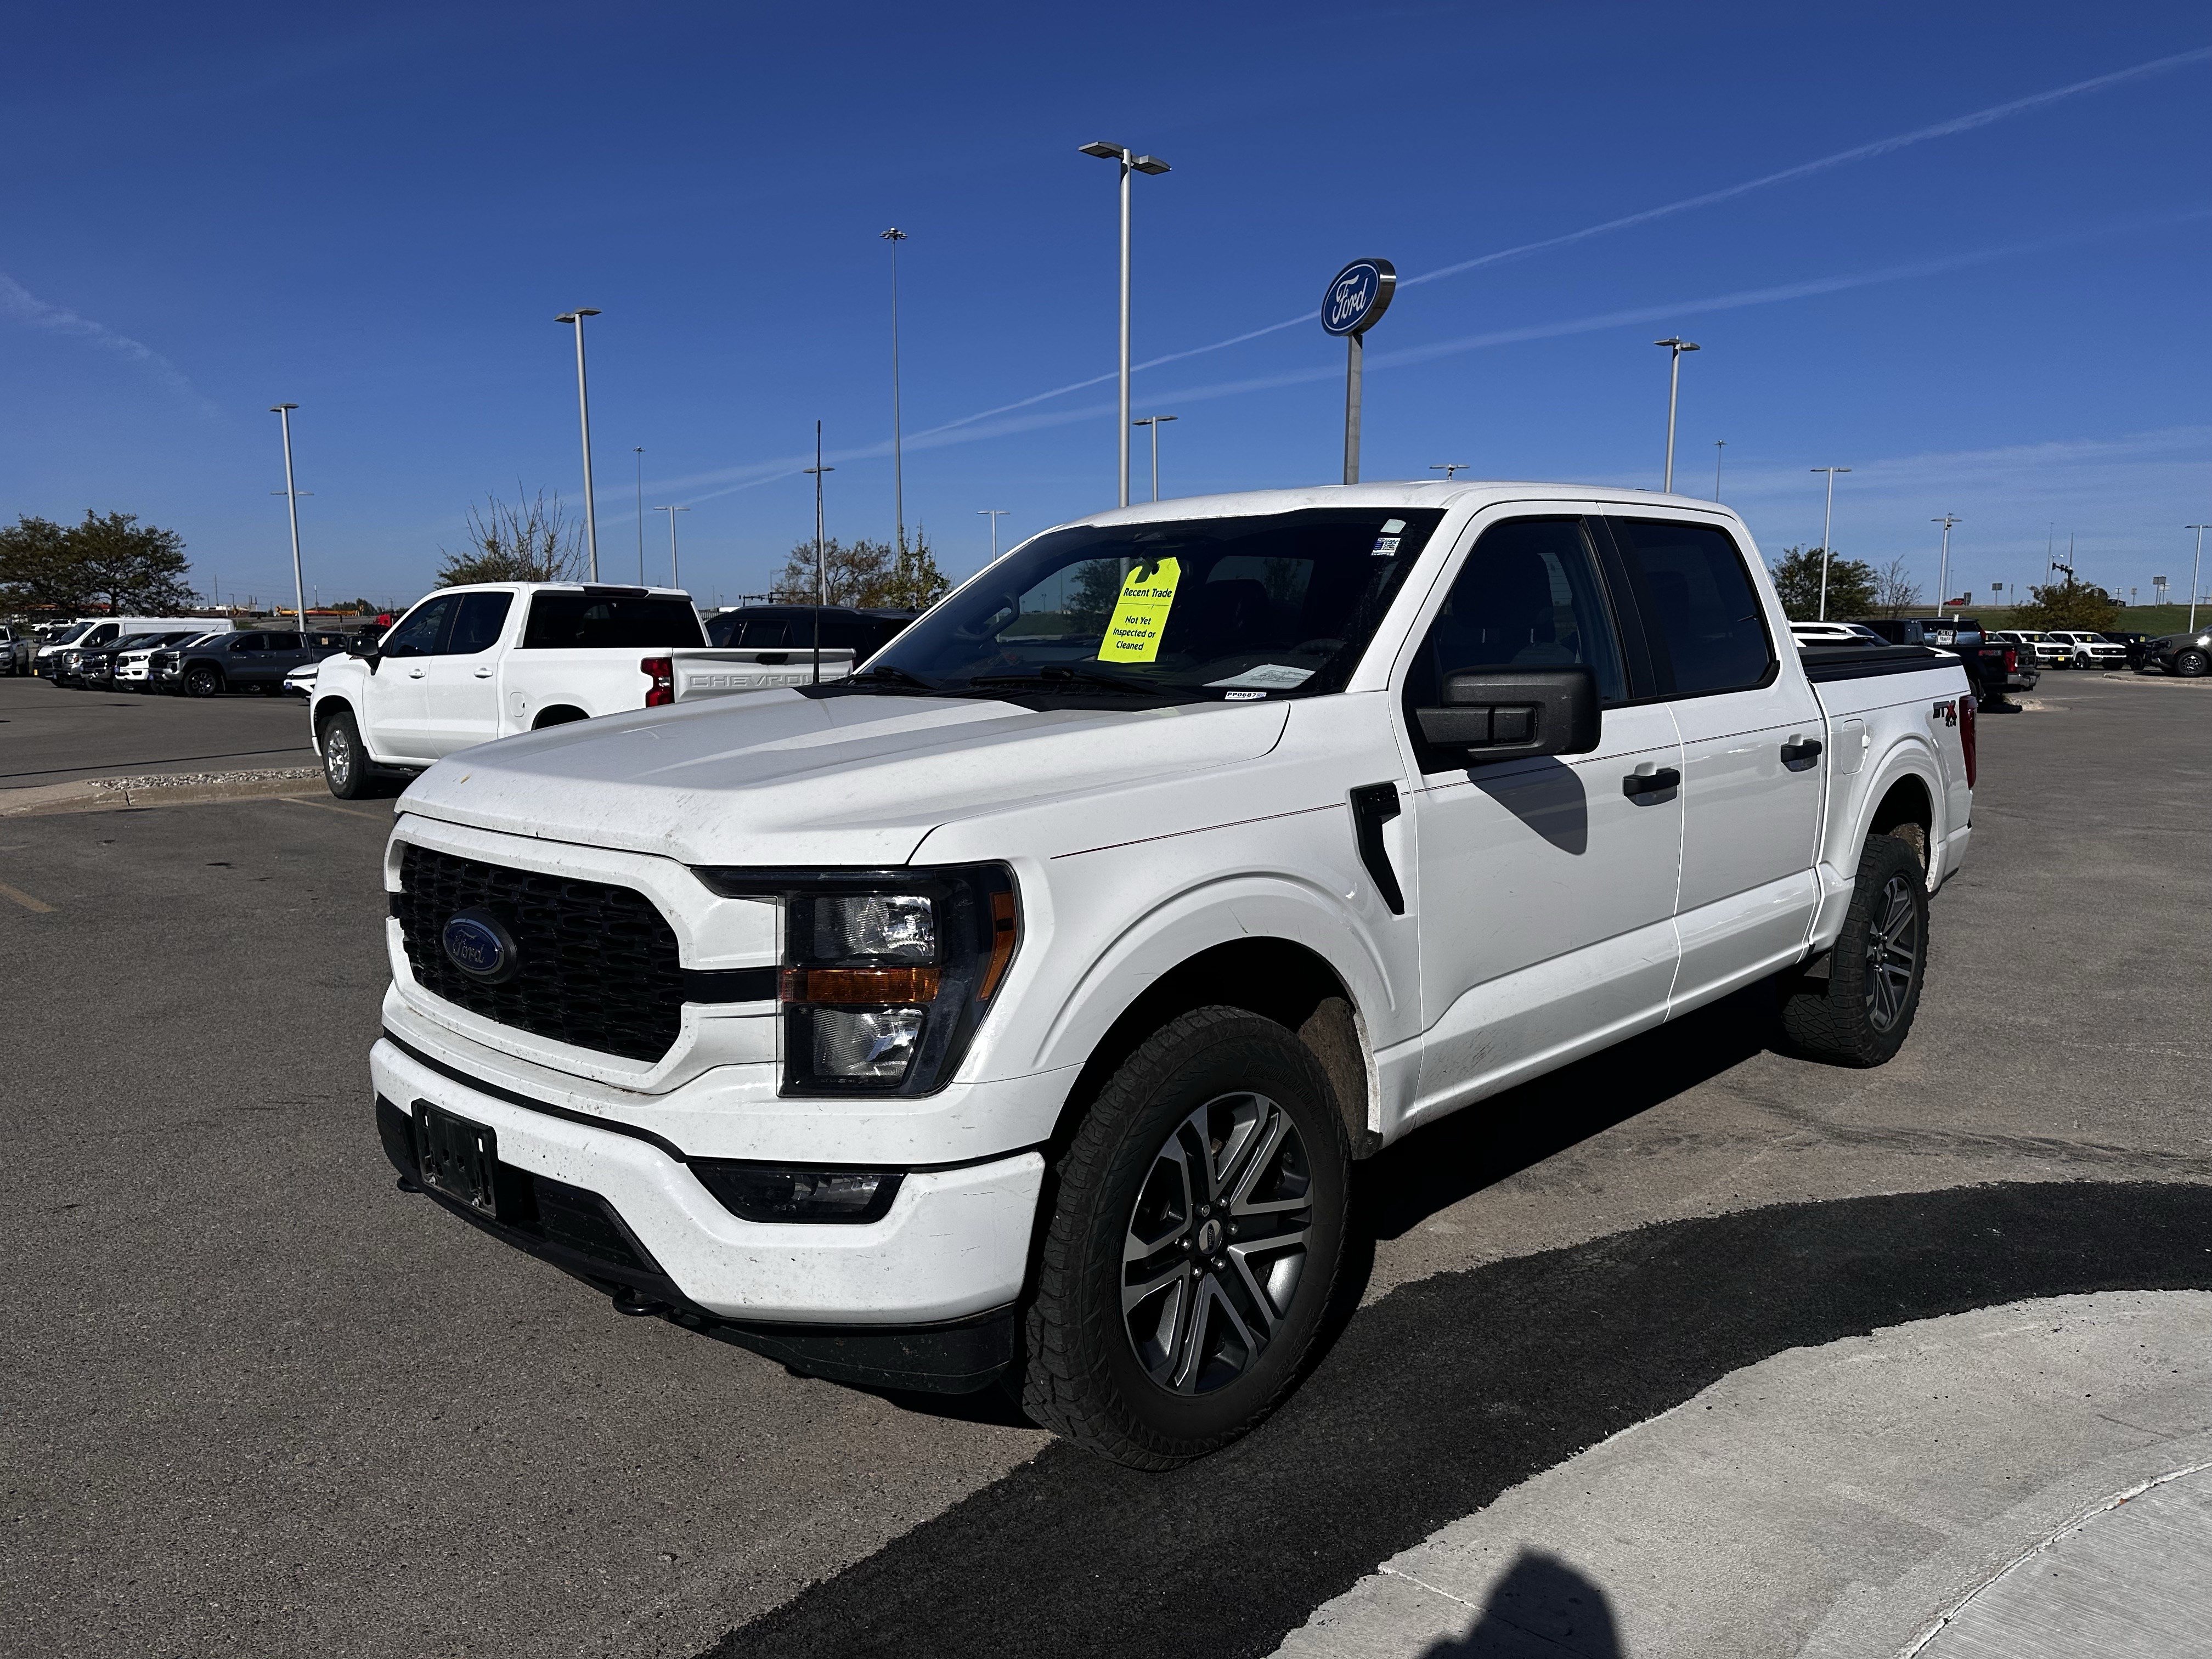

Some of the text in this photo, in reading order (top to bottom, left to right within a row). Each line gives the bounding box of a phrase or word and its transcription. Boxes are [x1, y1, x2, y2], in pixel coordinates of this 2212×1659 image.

[1332, 274, 1368, 324] Ford
[1123, 588, 1172, 597] Recent Trade
[1125, 616, 1152, 625] Not Yet
[1113, 628, 1147, 637] Inspected
[1116, 641, 1144, 650] Cleaned
[453, 928, 486, 964] Ford
[1106, 1234, 1124, 1352] KUMHO
